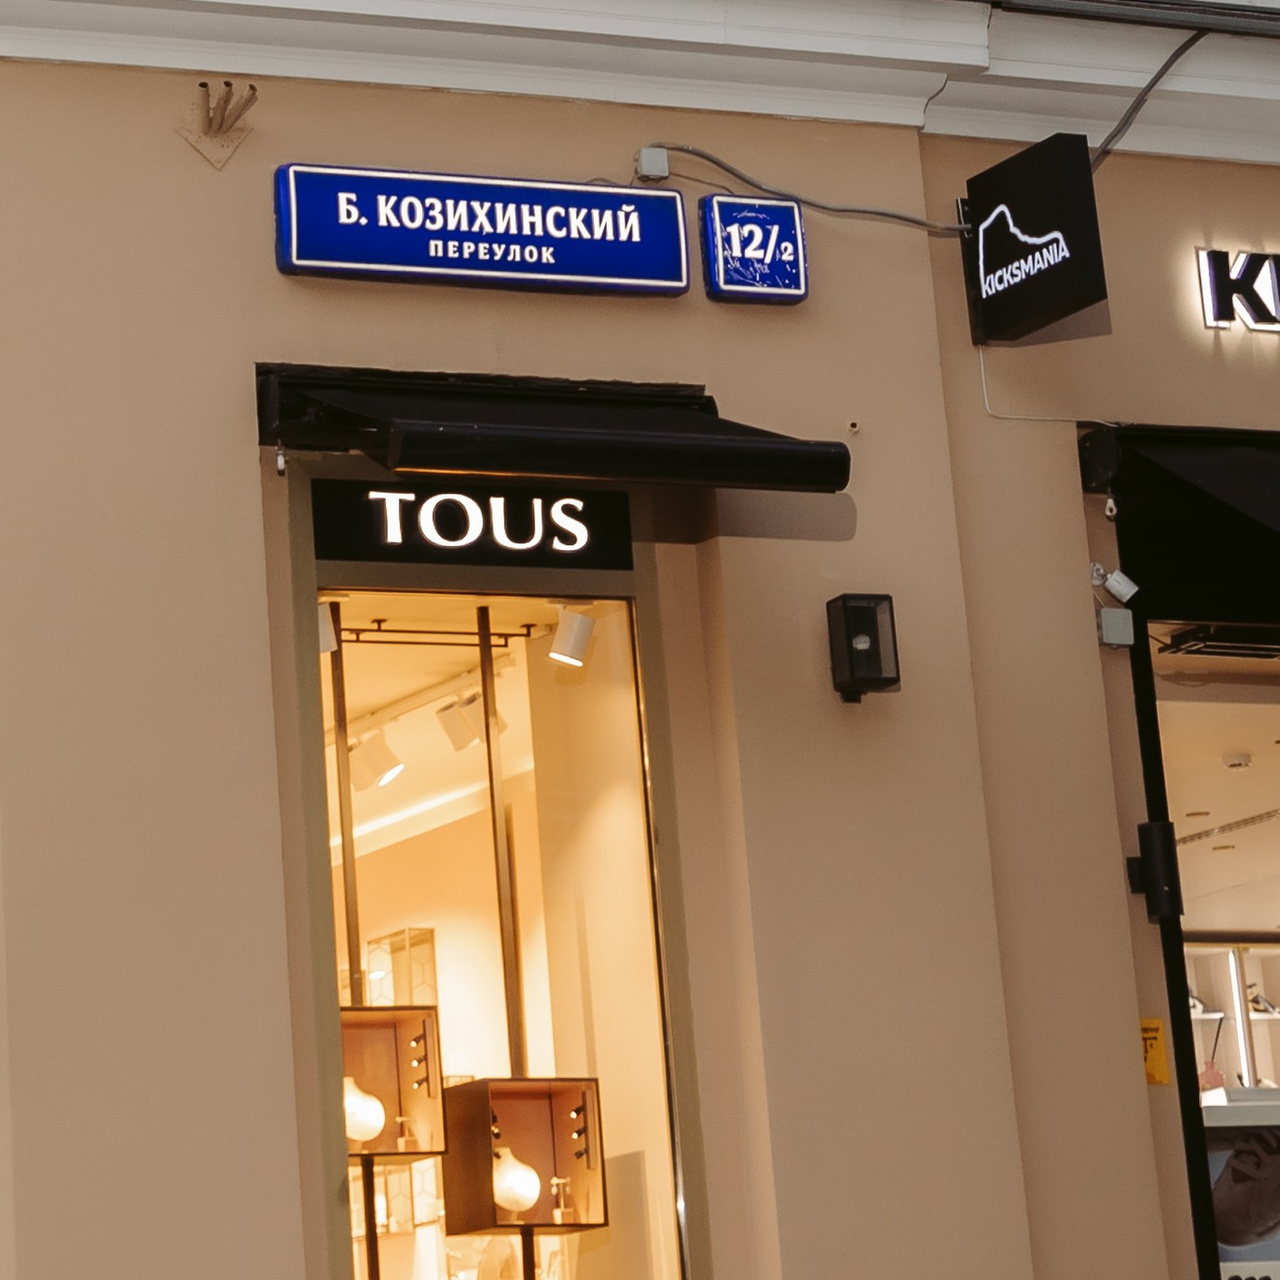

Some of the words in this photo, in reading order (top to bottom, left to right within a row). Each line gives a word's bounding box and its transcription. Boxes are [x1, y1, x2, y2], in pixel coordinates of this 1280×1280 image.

[337, 192, 369, 226] Б.
[376, 194, 641, 242] КОЗИХИНСКИЙ
[428, 239, 556, 264] ПЕРЕУЛОК
[726, 222, 795, 265] 12/2
[981, 238, 1070, 299] KICKSMANIA
[368, 490, 590, 552] TOUS
